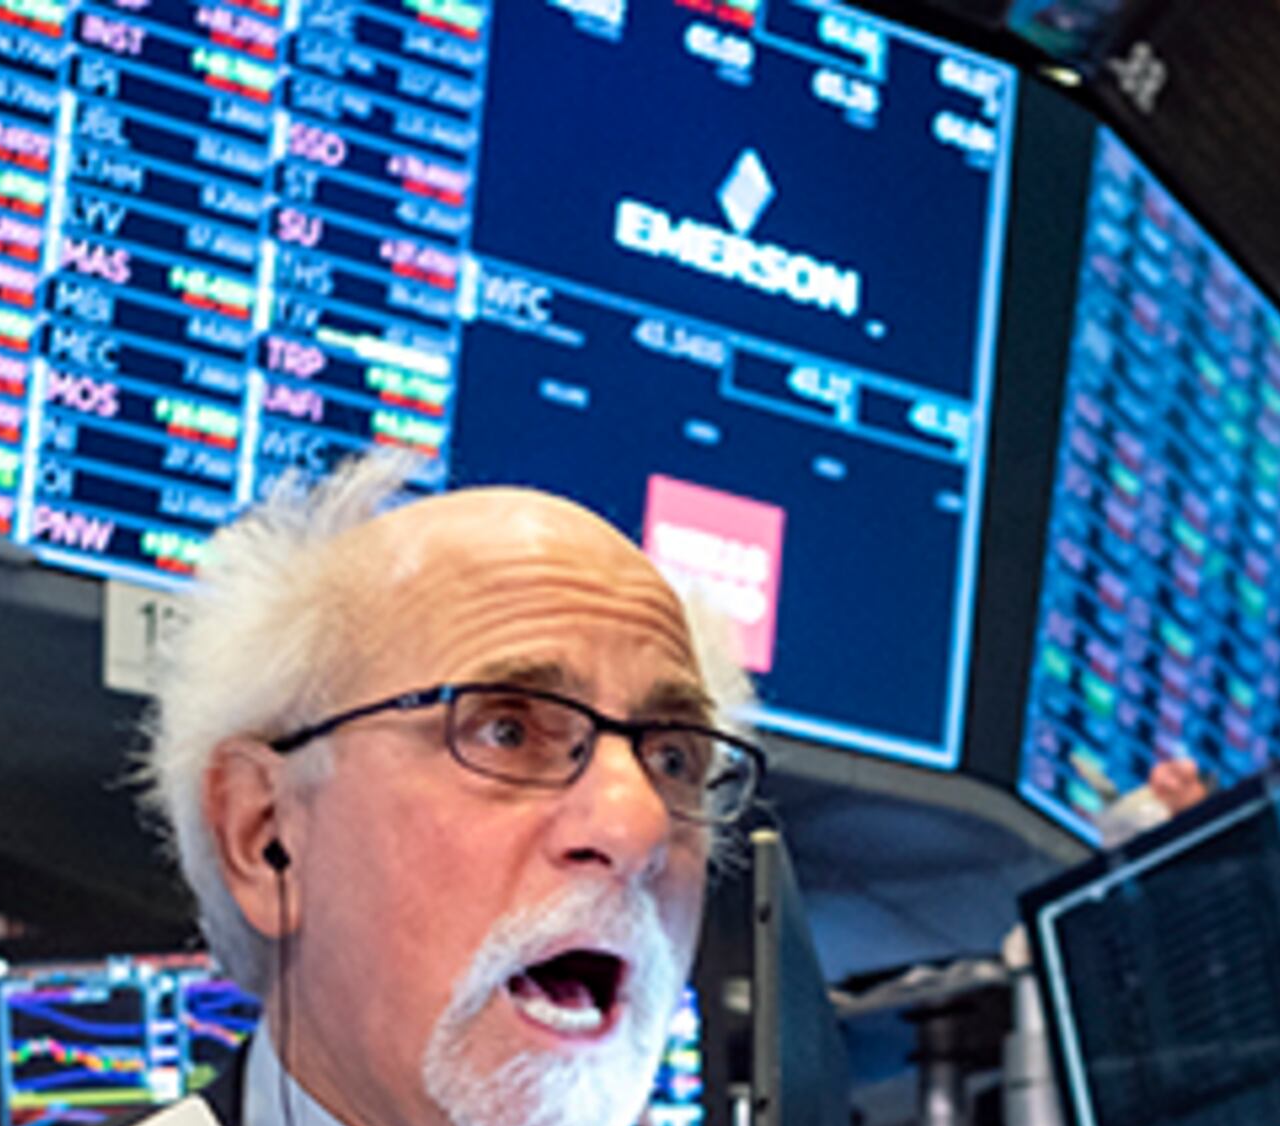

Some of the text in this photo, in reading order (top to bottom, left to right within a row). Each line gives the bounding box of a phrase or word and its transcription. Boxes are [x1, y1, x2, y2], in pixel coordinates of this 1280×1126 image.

[61, 236, 131, 284] MAS
[615, 198, 860, 316] EMERSON
[267, 335, 326, 379] TRP
[45, 371, 119, 418] MOS
[34, 505, 114, 552] PNW
